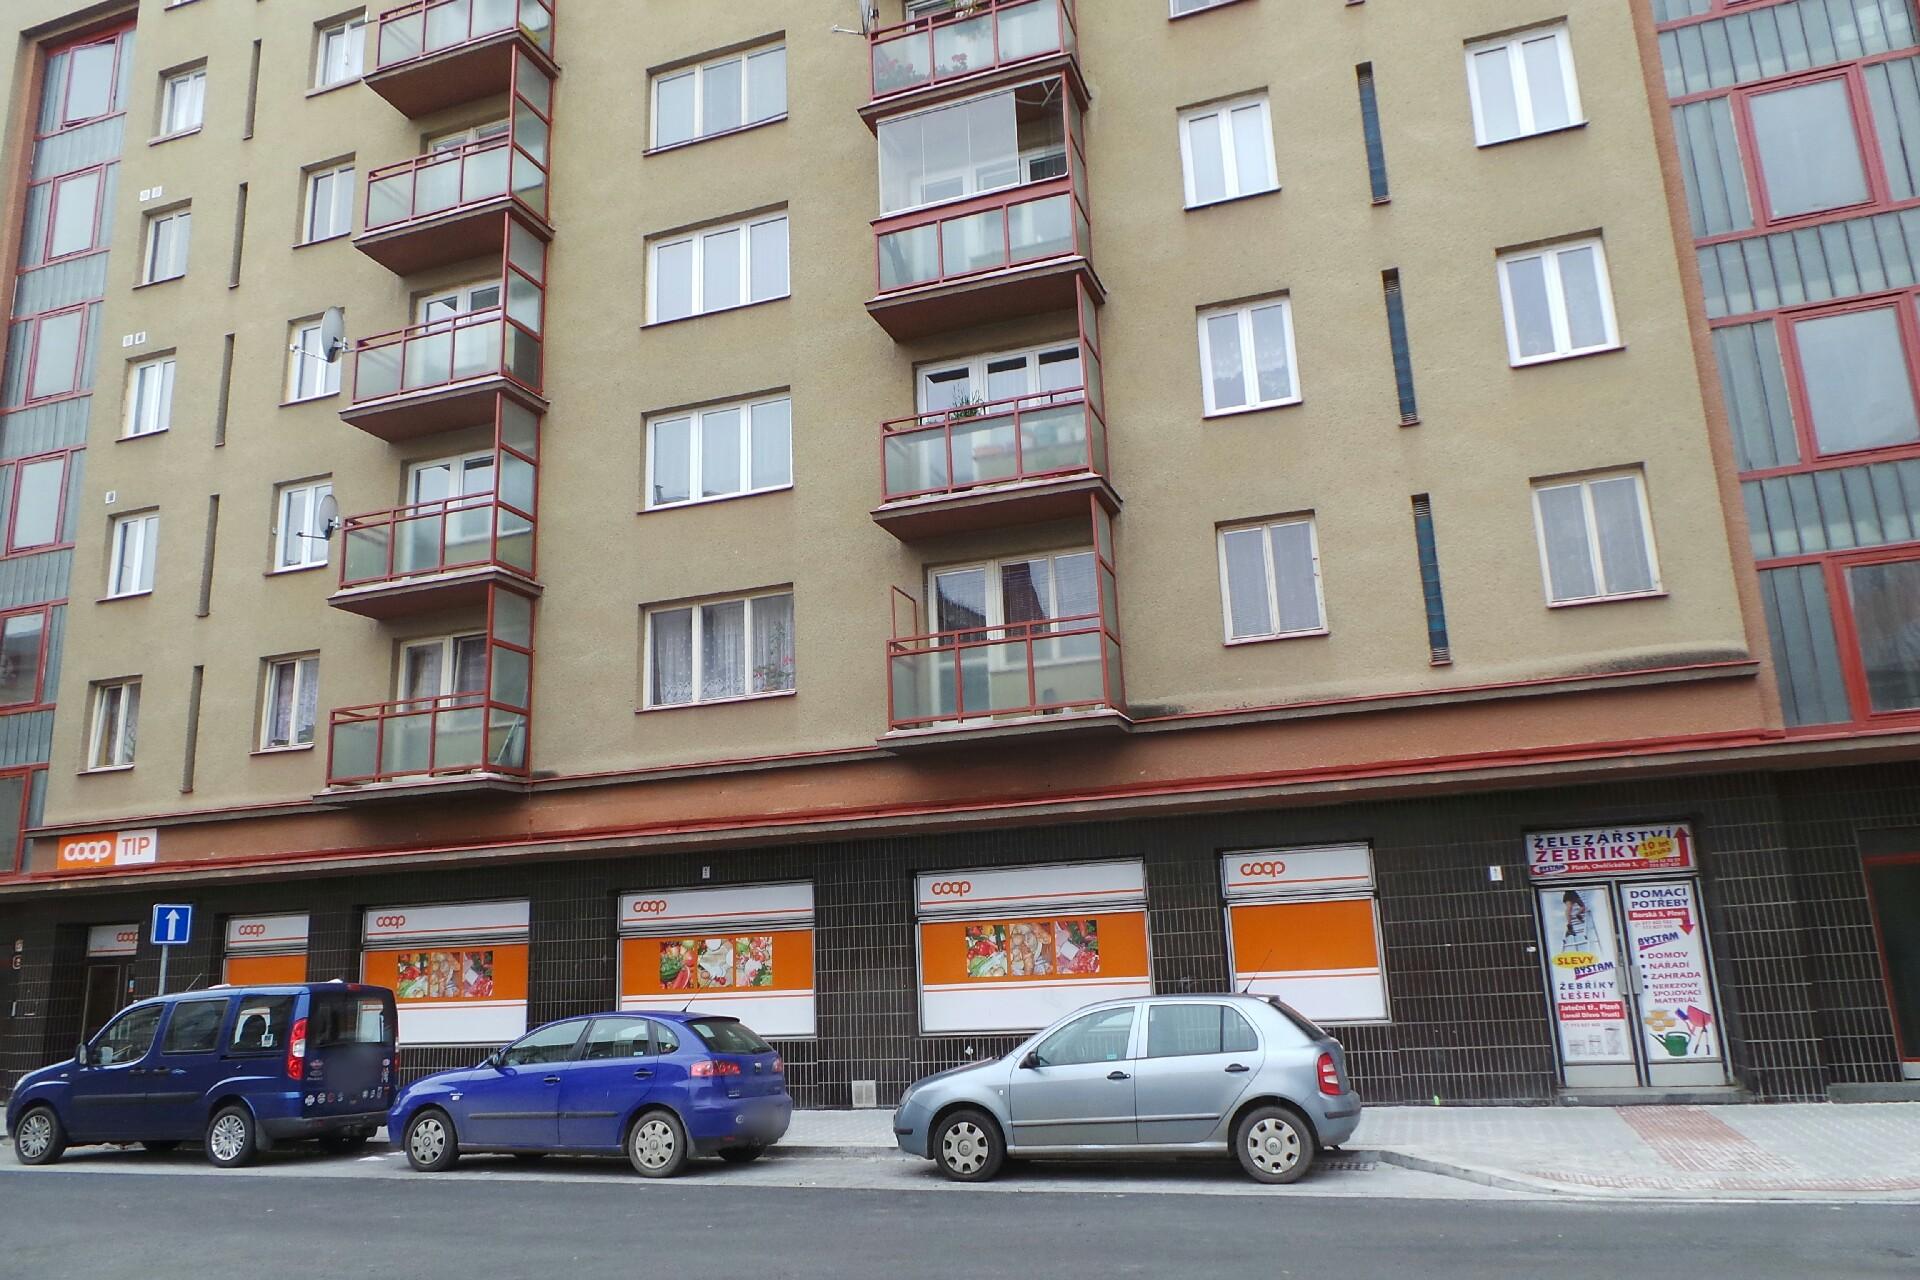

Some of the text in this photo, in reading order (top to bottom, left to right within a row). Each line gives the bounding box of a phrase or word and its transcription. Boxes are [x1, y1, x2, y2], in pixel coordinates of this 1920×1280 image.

[1534, 828, 1671, 849] ŽELEZÁŘSTVÍ
[64, 836, 151, 862] coop TIP
[1535, 843, 1640, 863] ŽEBŘÍKY
[1239, 860, 1286, 878] coop
[931, 880, 972, 897] coop
[633, 899, 667, 915] coop
[1632, 898, 1689, 909] POTŘEBY
[376, 914, 406, 929] coop
[238, 924, 266, 937] coop
[1638, 931, 1680, 946] BYSTAM
[1557, 956, 1594, 966] SLEVY
[1648, 951, 1689, 959] DOMOV
[1573, 961, 1615, 975] BYSTAM
[1651, 971, 1702, 980] ZAHRADA
[1560, 981, 1615, 991] ŽEBŘÍKY
[1560, 990, 1606, 1000] LEŠENÍ
